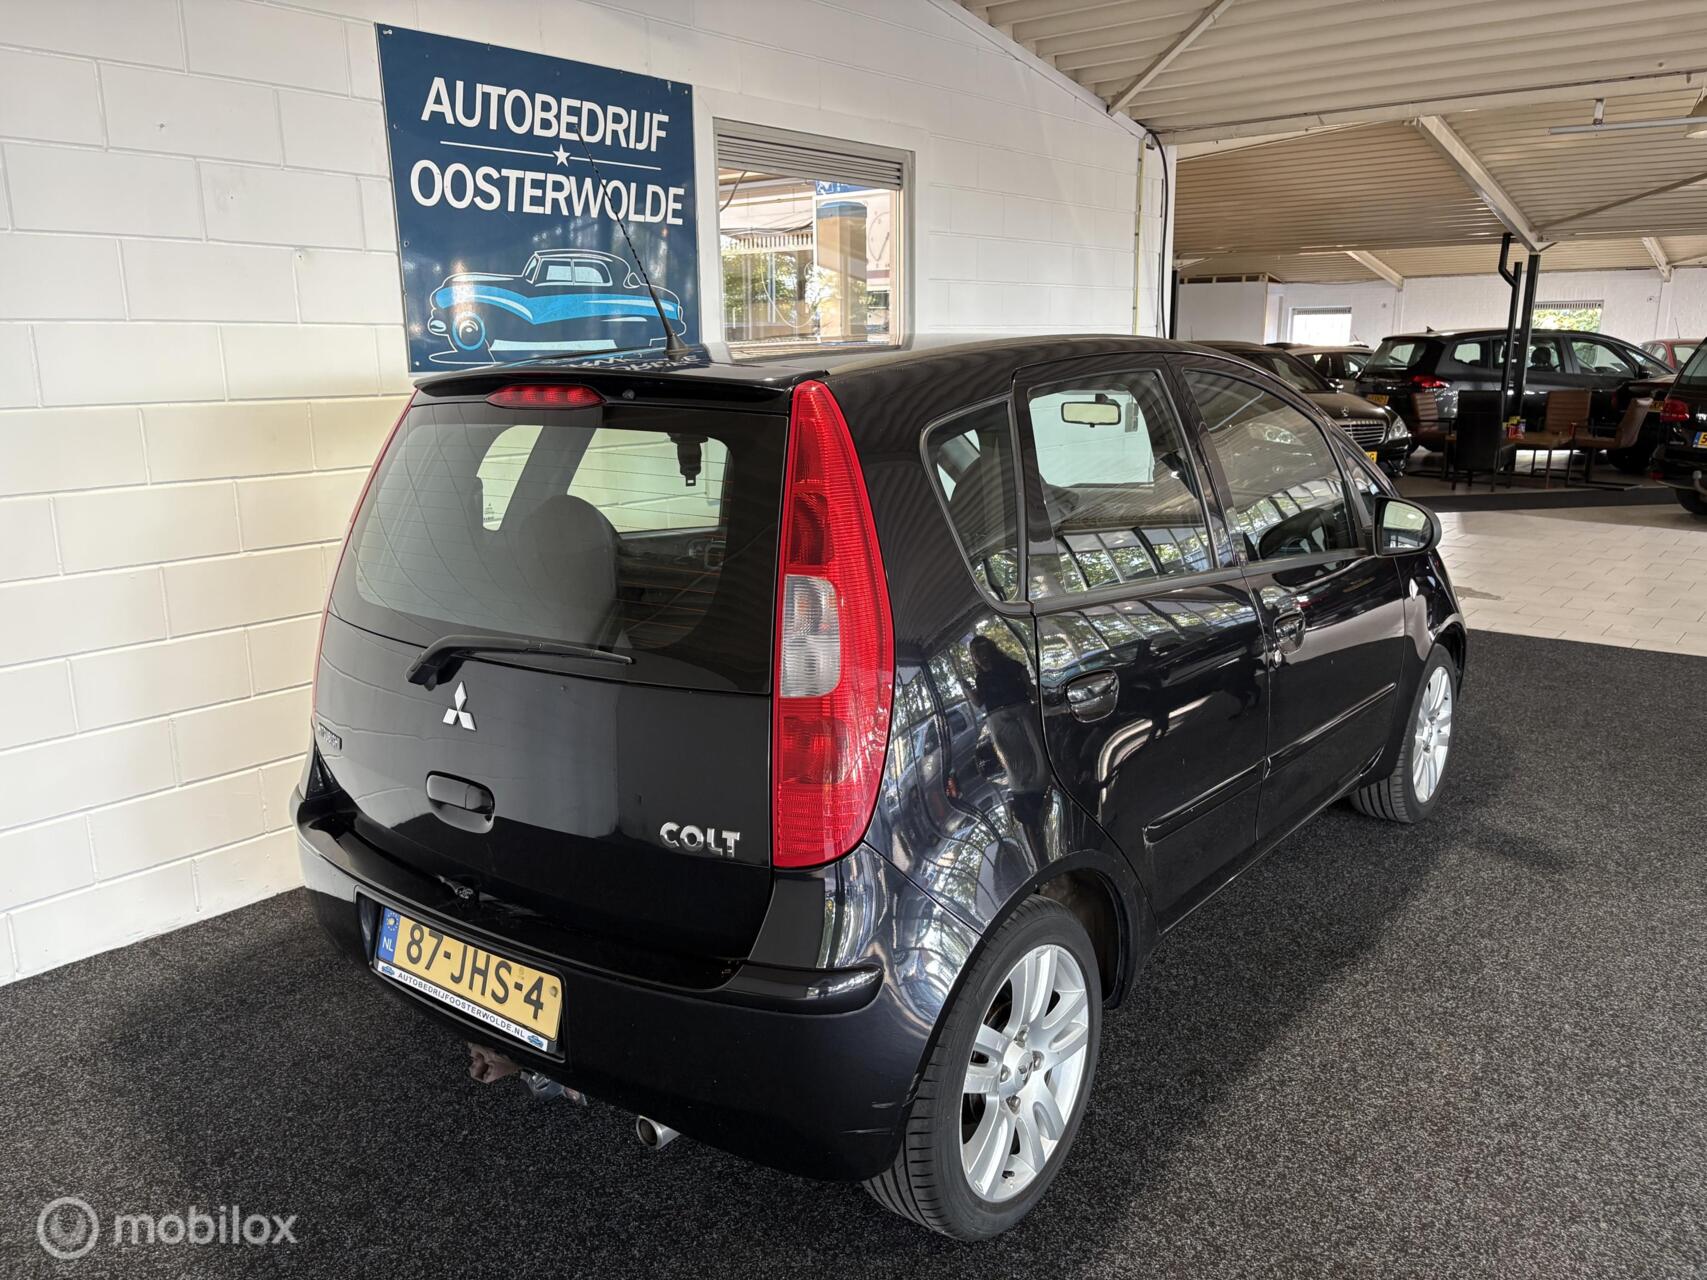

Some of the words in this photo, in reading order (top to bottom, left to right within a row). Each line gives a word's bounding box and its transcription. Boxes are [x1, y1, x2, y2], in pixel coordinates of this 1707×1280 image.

[421, 76, 669, 152] AUTOBEDRIJF
[410, 160, 685, 225] OOSTERWOLDE
[660, 822, 740, 857] COLT
[382, 936, 394, 952] NL
[406, 923, 544, 1020] 87-JHS-4
[397, 972, 525, 1038] AUTOBEDRIJFOOSTERWOLDE.NL
